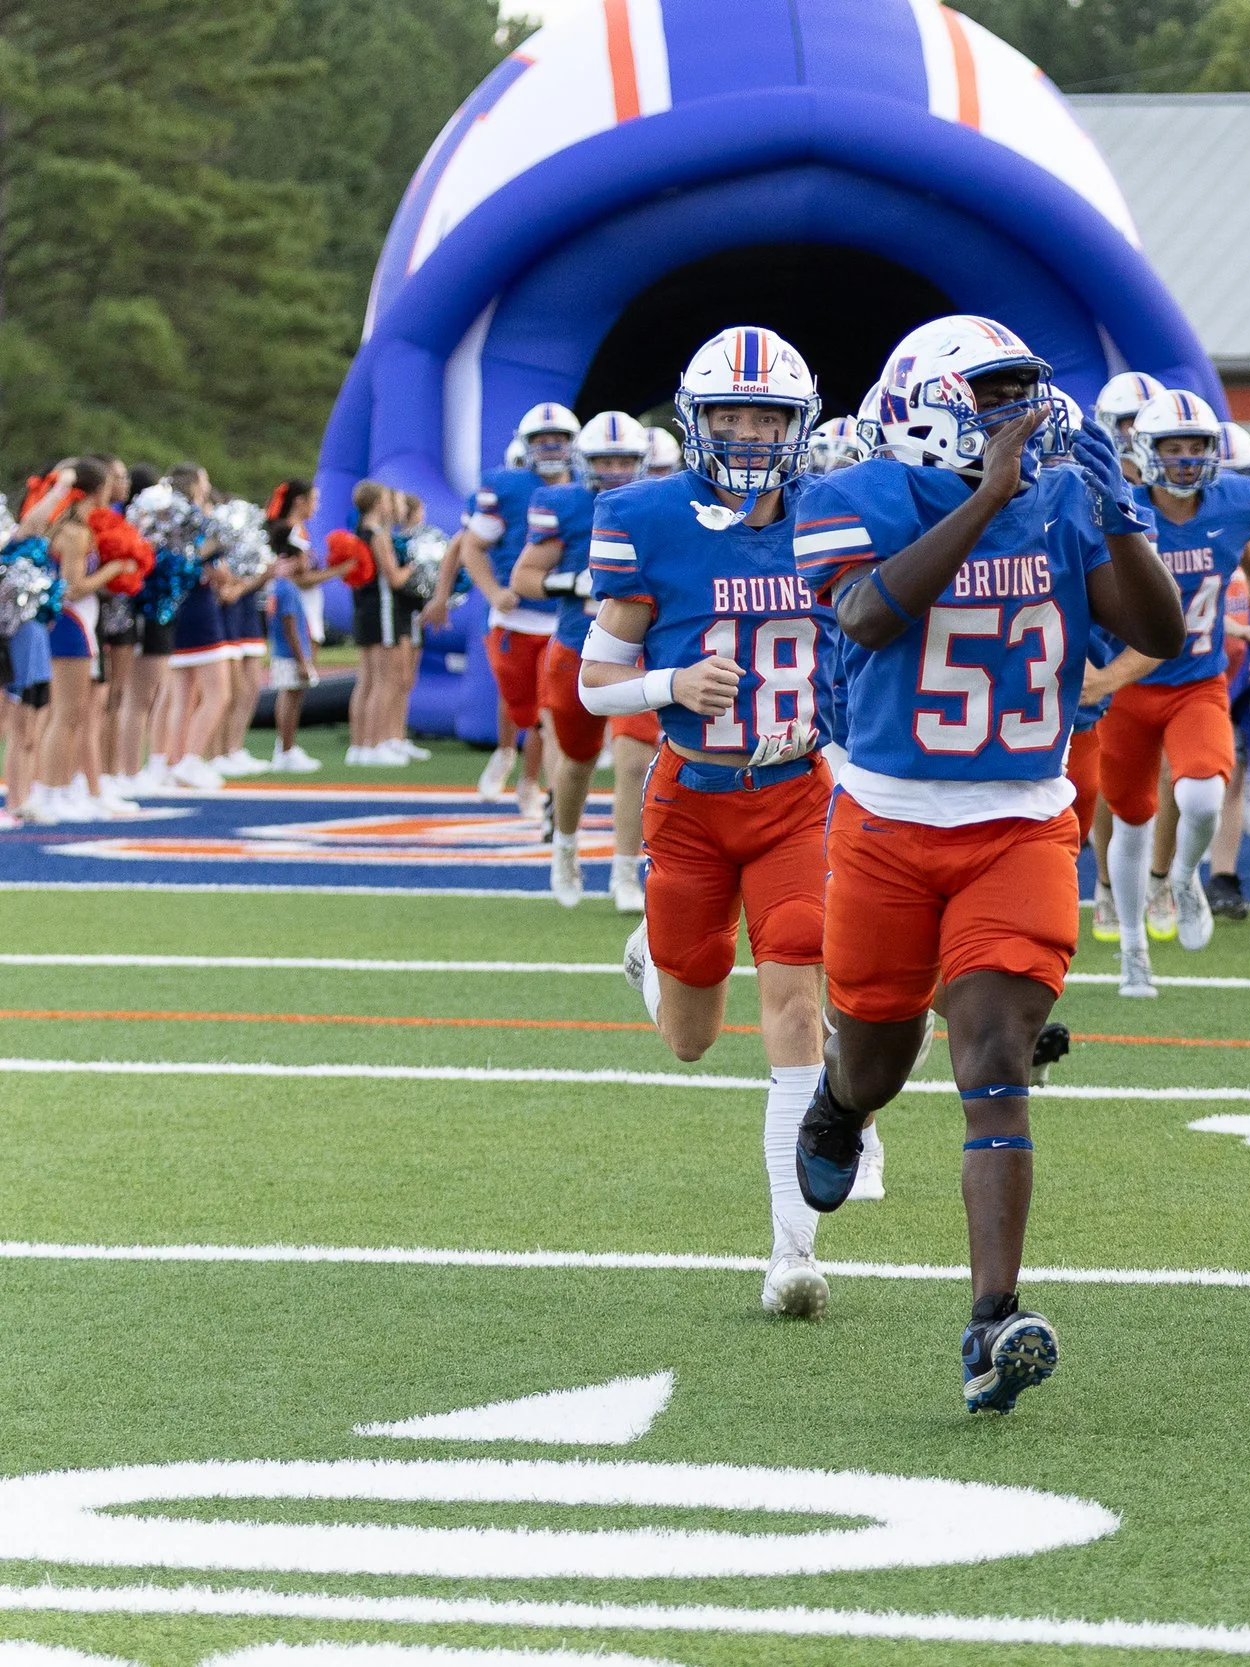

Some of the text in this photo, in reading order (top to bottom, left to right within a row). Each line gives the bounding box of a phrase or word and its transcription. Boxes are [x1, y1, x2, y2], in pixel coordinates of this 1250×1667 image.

[732, 384, 769, 394] Riddell
[953, 554, 1052, 597] BRUINS
[1162, 547, 1214, 575] RUINS
[712, 576, 812, 612] BRUINS
[1180, 573, 1223, 656] 4
[701, 616, 821, 750] 18
[912, 598, 1068, 756] 53
